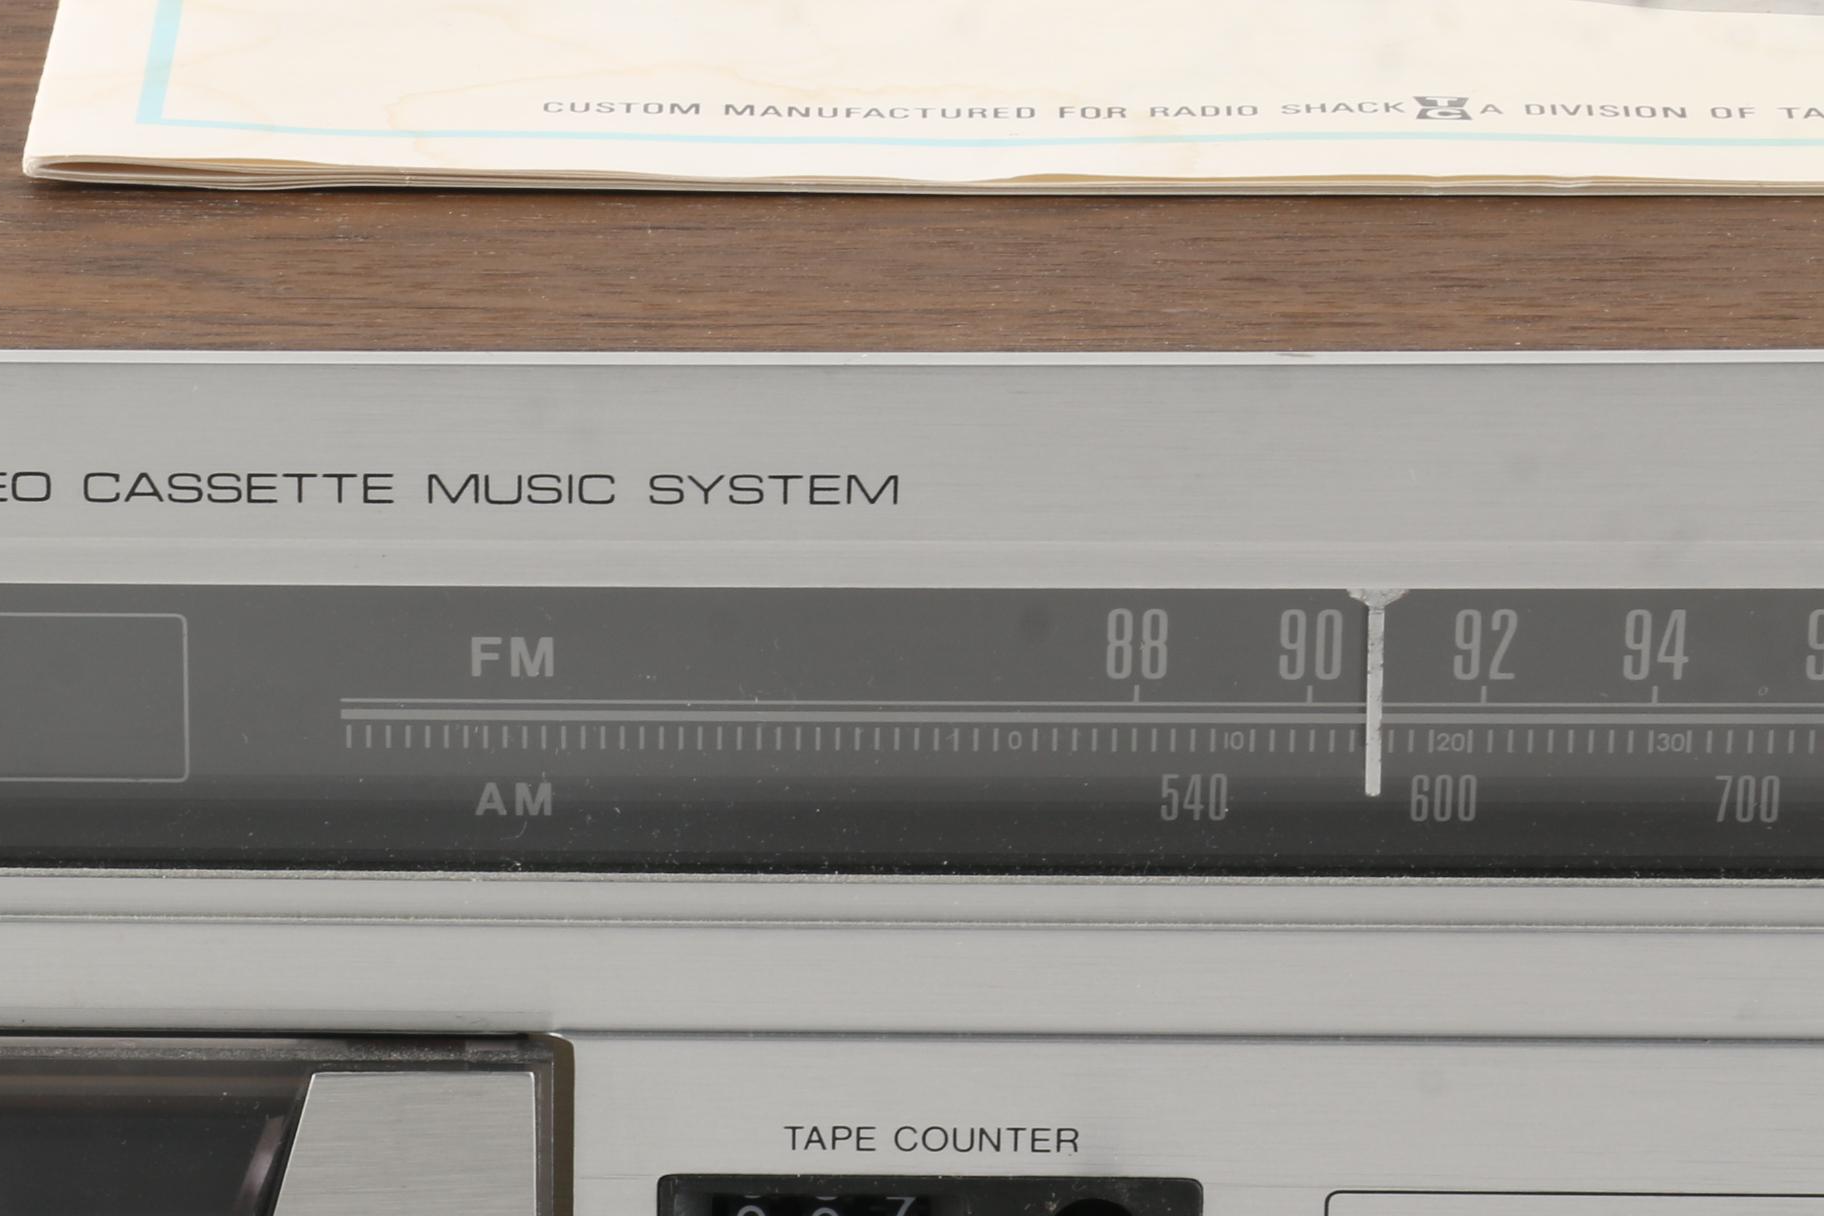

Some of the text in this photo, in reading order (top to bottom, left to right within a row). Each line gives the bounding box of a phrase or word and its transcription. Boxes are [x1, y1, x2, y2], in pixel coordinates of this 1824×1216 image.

[543, 102, 701, 115] CUSTOM
[724, 103, 1036, 119] MANUFACTURED
[1058, 106, 1127, 120] FOR
[1149, 105, 1259, 118] RADIO
[1281, 101, 1405, 115] SHACK
[1479, 103, 1503, 115] A
[1524, 103, 1687, 119] DIVISION
[1710, 107, 1753, 119] OF
[83, 472, 395, 504] CASSETTE
[427, 473, 616, 505] MUSIC
[649, 474, 899, 506] SYSTEM
[471, 636, 554, 678] FM
[1106, 607, 1169, 680] 88
[1278, 608, 1343, 681] 90
[1453, 608, 1518, 681] 92
[1622, 608, 1689, 681] 94
[1007, 730, 1686, 753] 0 10 20 30
[475, 773, 1780, 824] AM 540 600 700
[783, 1125, 1079, 1153] TAPE COUNTER
